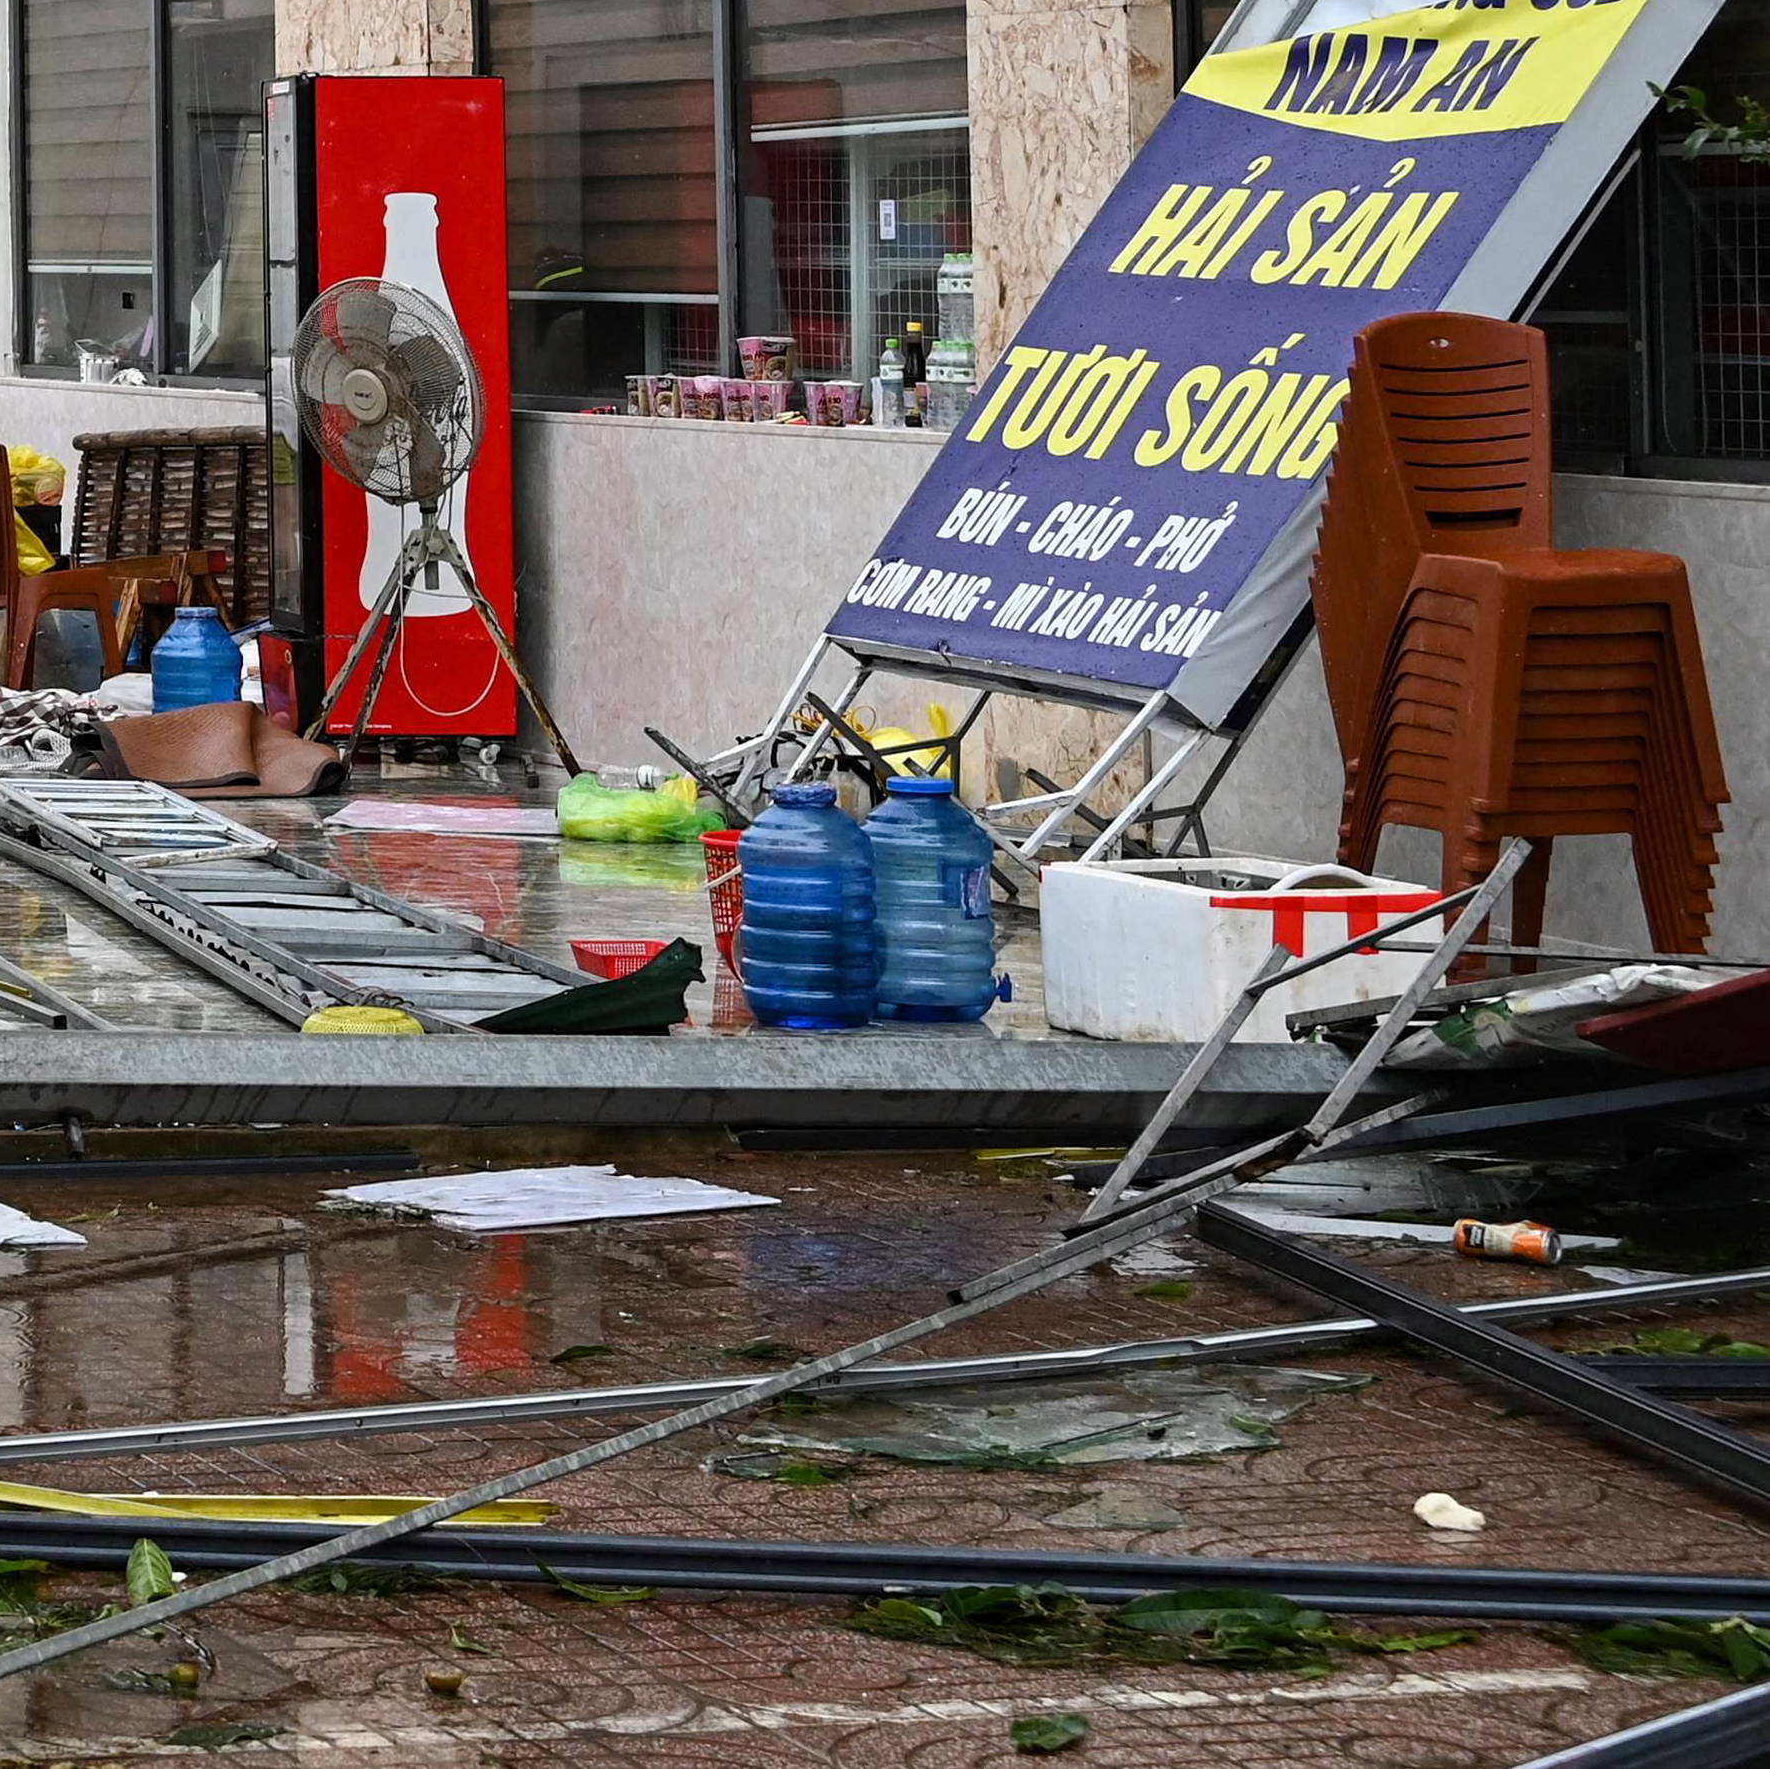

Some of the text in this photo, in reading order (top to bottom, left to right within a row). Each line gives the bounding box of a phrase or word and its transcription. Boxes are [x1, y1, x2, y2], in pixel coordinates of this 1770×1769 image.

[1263, 32, 1540, 114] NAM AN
[1108, 155, 1459, 290] HẢI SẢN
[966, 333, 1351, 479] TƯƠI SỐNG
[936, 481, 1028, 545] BÚN
[1028, 496, 1134, 561] CHÁO
[1134, 501, 1238, 573] PHỞ
[846, 558, 922, 609] CƠM
[903, 569, 991, 621] RANG
[991, 576, 1054, 630] MÌ
[1028, 582, 1104, 640] XÀO
[1087, 584, 1159, 647] HẢI
[1140, 591, 1222, 658] SẢN
